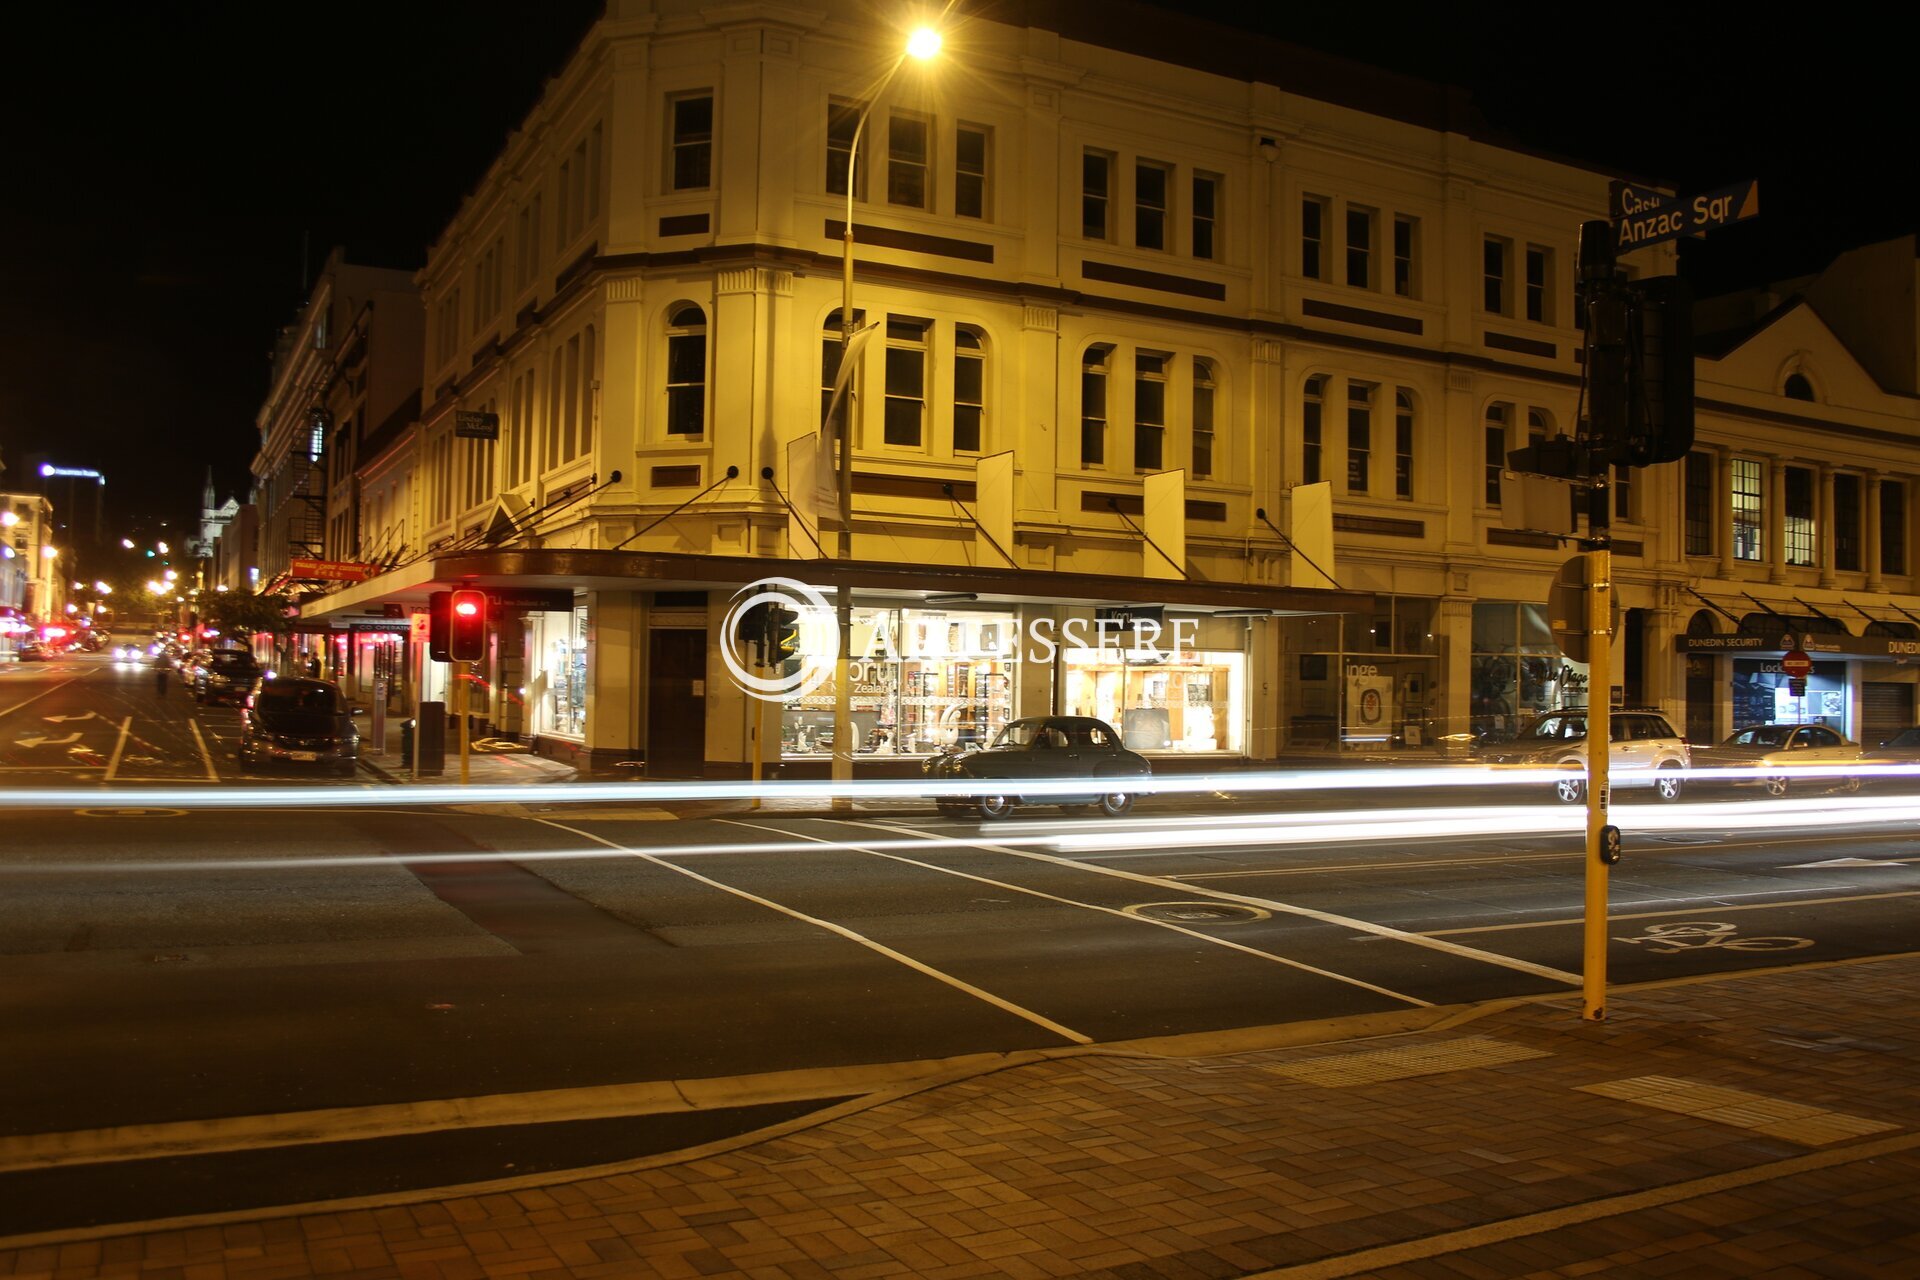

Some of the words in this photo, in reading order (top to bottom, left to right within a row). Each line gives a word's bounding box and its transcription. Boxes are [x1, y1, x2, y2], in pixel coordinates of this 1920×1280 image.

[1618, 210, 1684, 247] Anzac
[1693, 195, 1734, 225] Sqr
[1688, 638, 1725, 648] DUNEDIN
[1726, 637, 1764, 647] SECURITY
